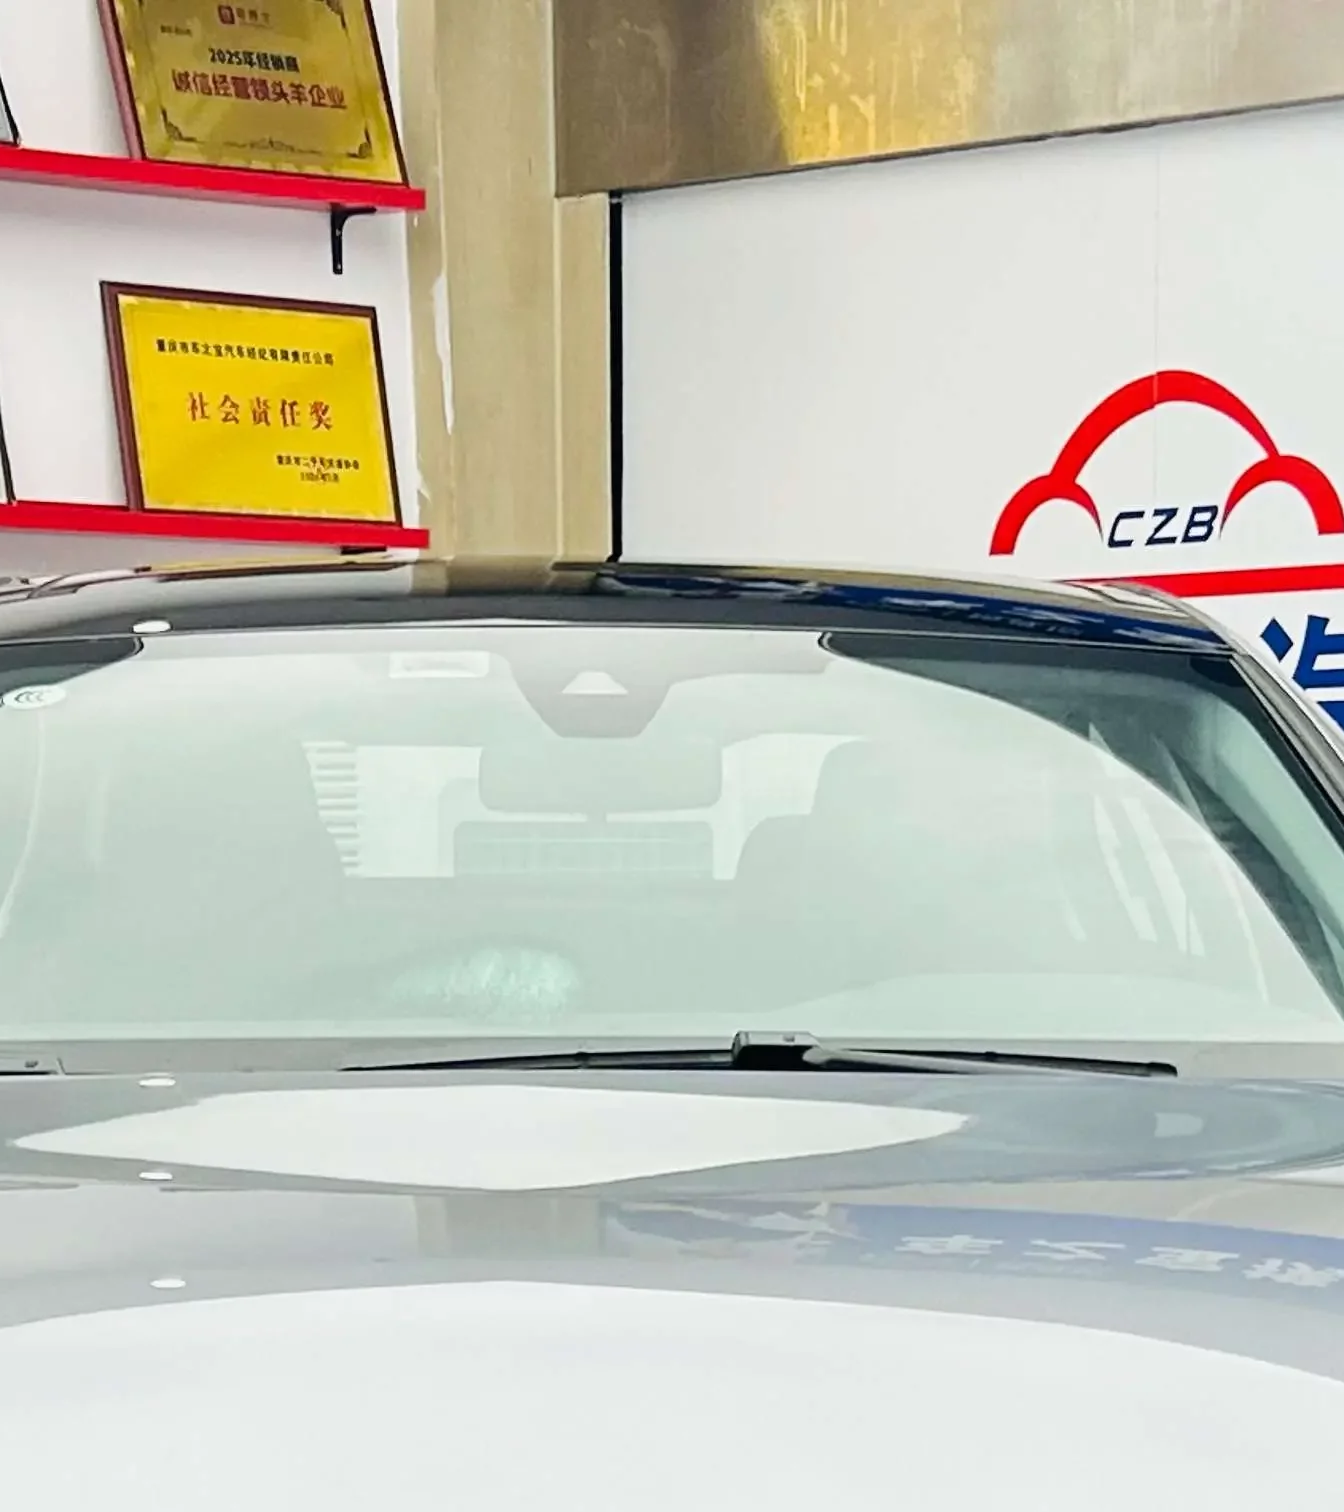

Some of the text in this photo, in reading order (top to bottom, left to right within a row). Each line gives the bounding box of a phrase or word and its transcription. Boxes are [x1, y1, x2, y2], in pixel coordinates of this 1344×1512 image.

[172, 68, 347, 110] 诚信经营领头羊企业
[188, 391, 333, 431] 社会责任奖
[1107, 504, 1219, 549] CZB
